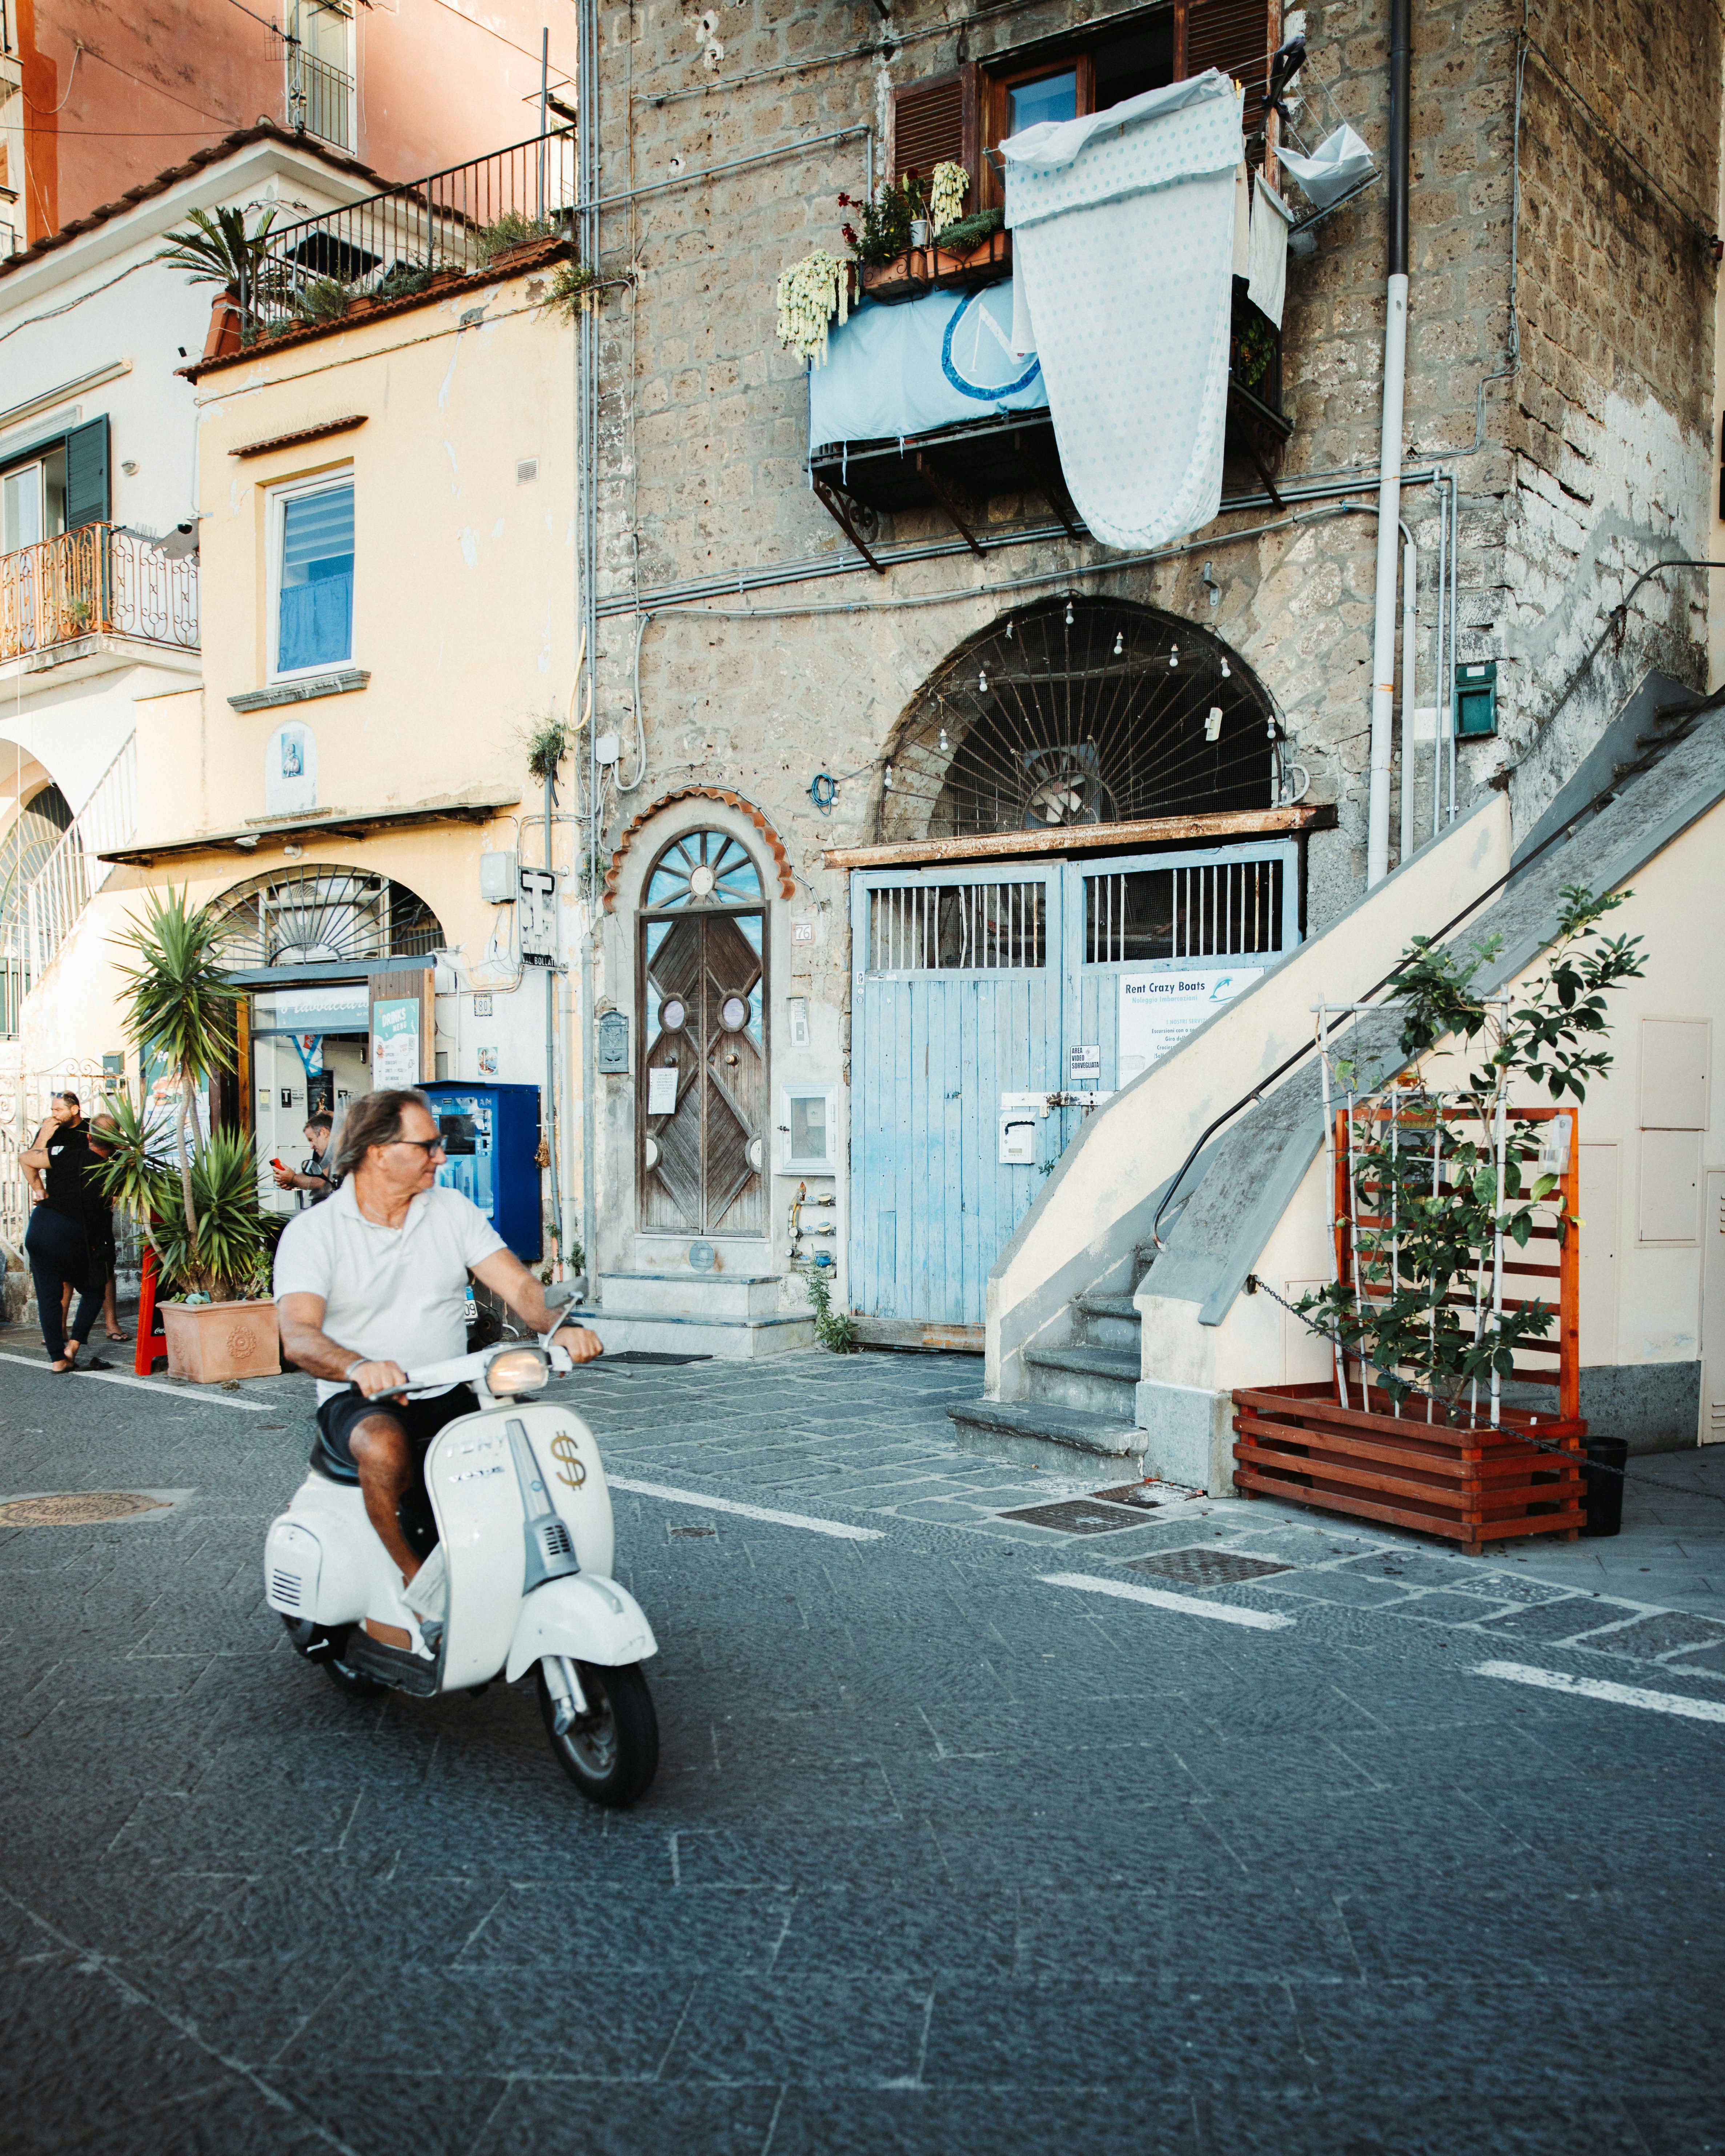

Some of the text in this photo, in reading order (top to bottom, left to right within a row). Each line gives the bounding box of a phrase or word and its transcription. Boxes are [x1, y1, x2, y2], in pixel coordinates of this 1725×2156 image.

[796, 927, 810, 939] 76
[1126, 981, 1205, 994] Rent Crazy Boats
[479, 1001, 488, 1011] 80
[382, 1007, 406, 1027] DRINKS
[393, 1021, 406, 1032] MENU
